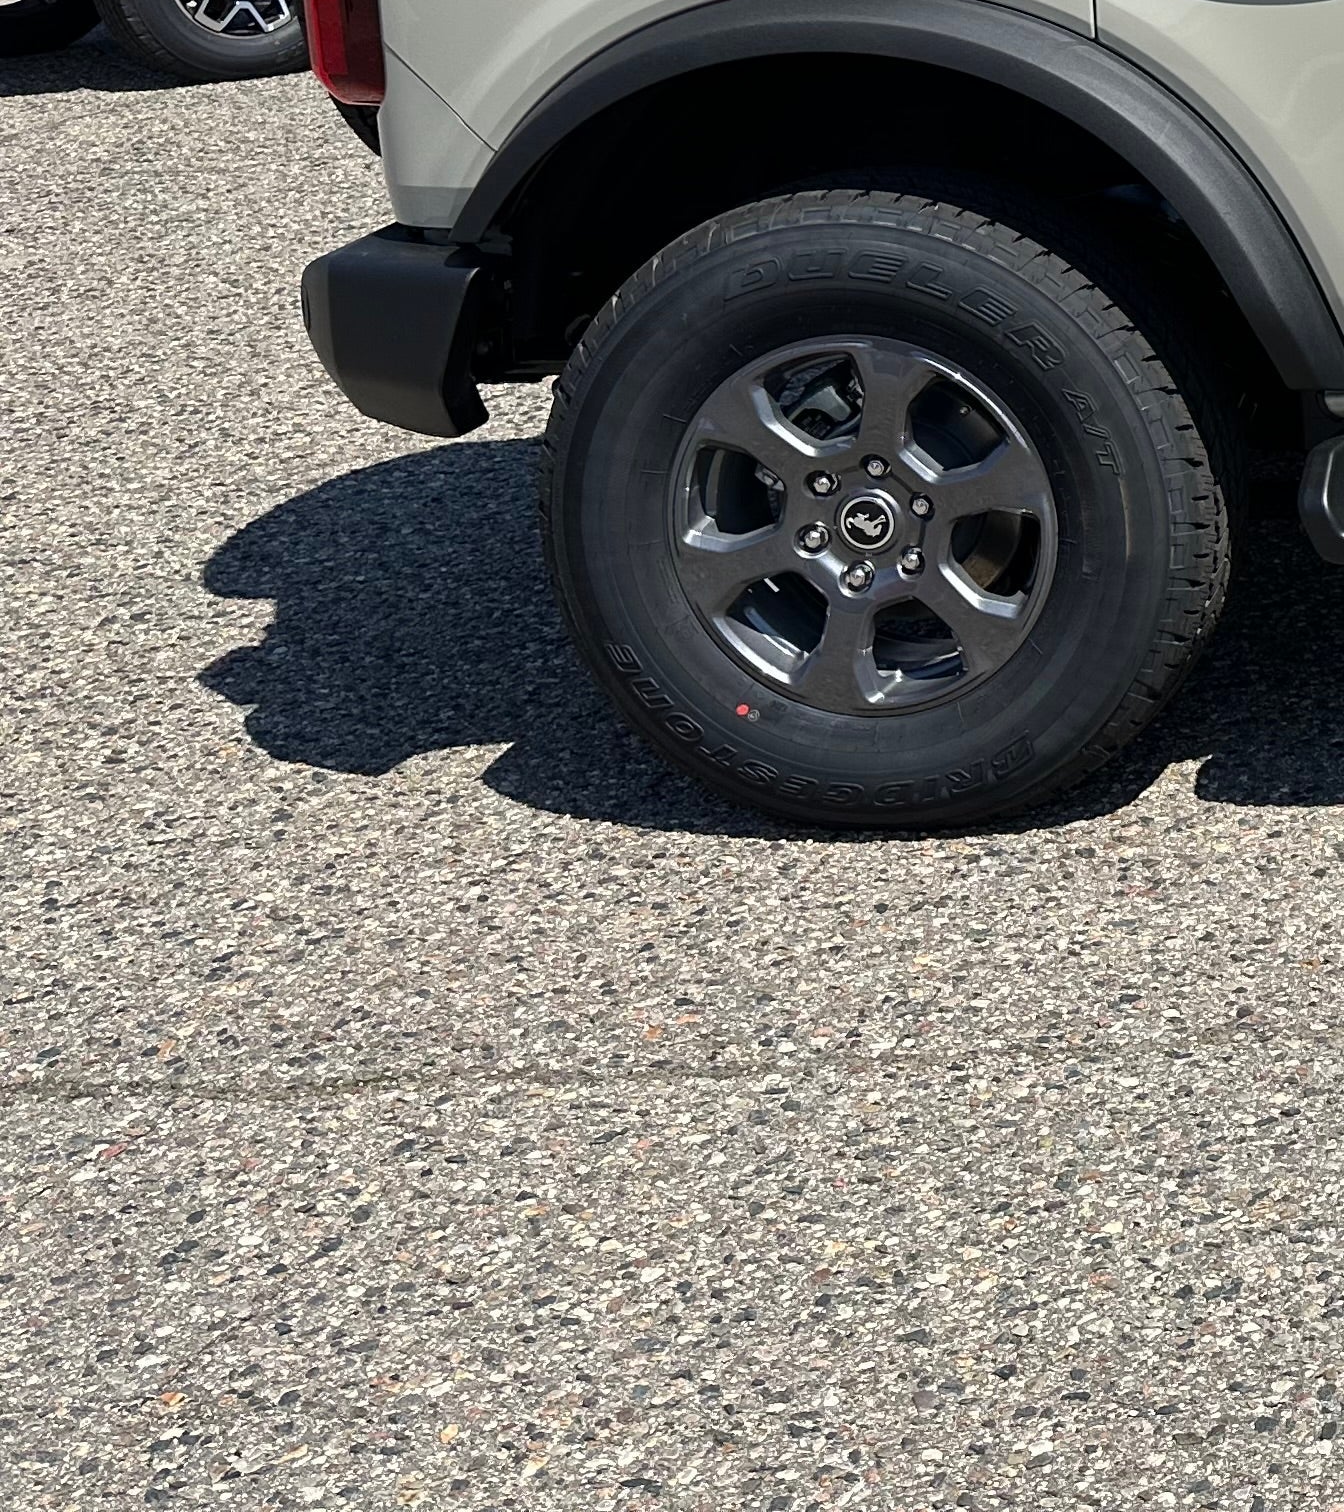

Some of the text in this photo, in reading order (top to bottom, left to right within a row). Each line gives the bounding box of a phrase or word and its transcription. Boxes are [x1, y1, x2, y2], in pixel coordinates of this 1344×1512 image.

[722, 248, 1125, 477] DUELER A/T
[604, 641, 1040, 809] BRIDGESTONE
